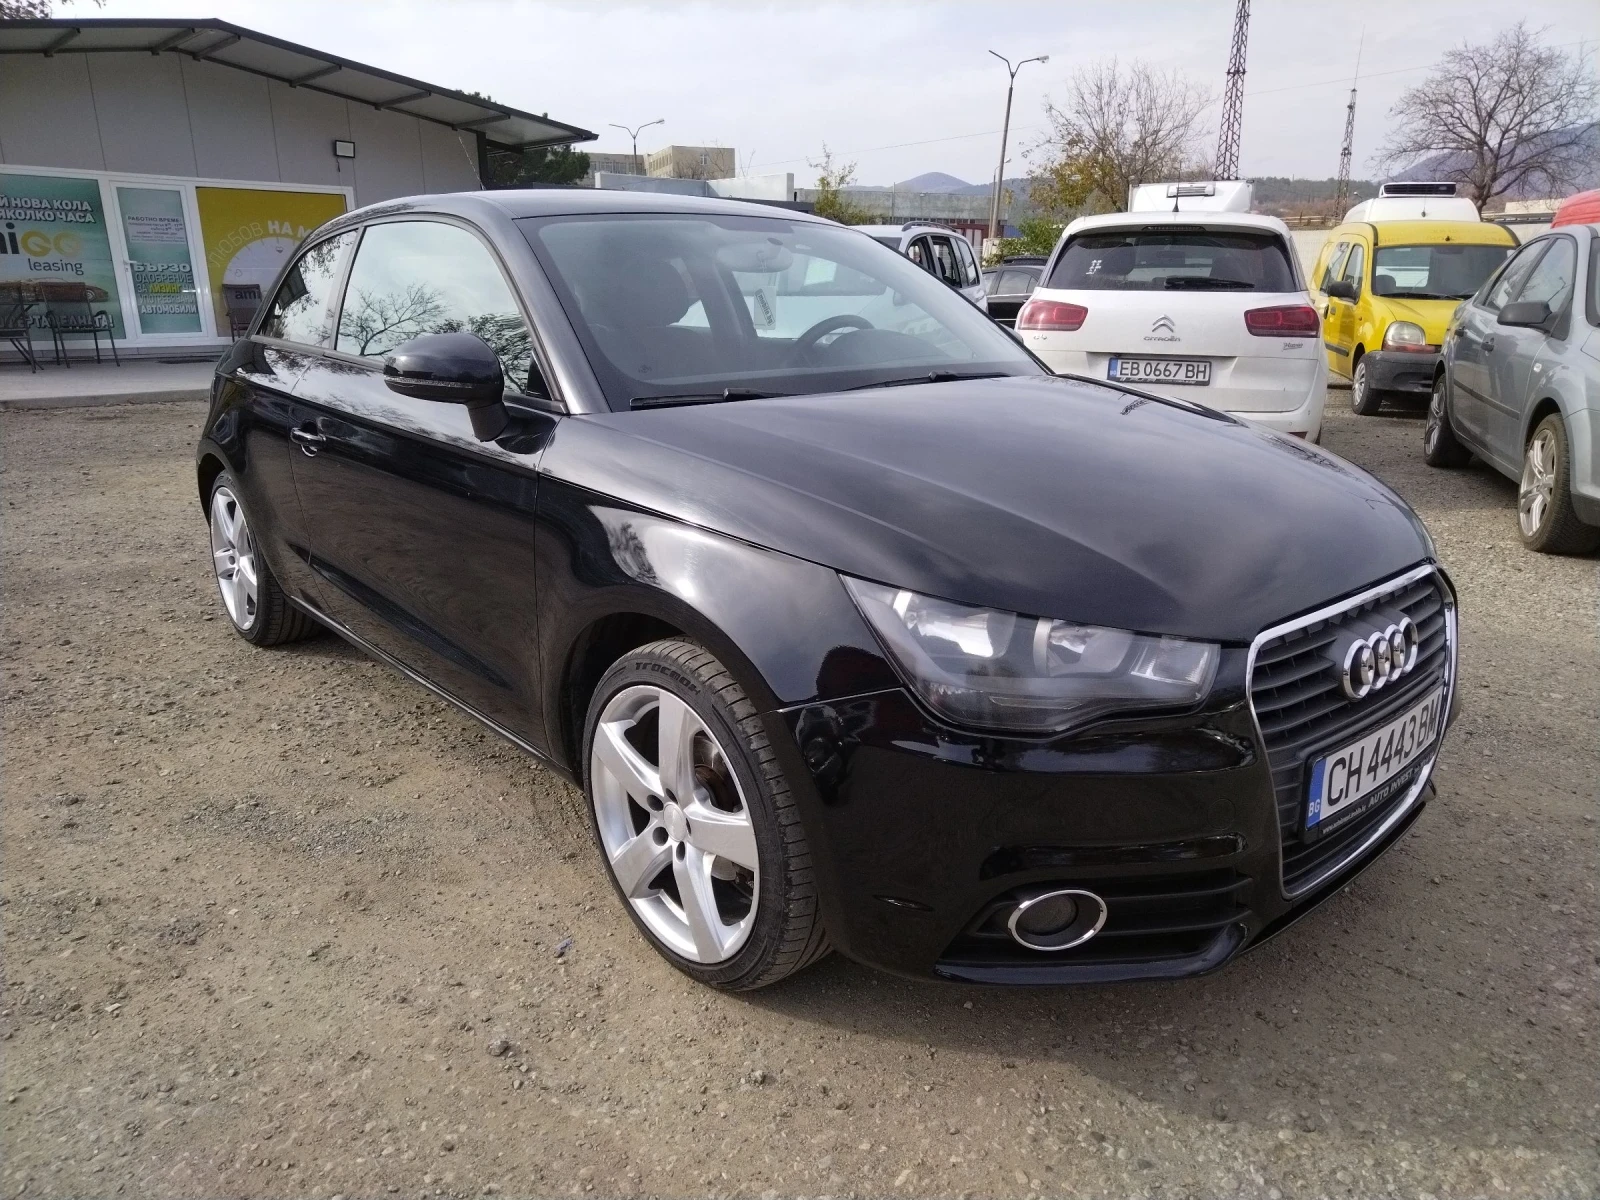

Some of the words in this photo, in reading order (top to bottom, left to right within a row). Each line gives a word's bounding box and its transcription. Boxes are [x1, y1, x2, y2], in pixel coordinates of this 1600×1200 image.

[11, 197, 52, 210] НОВА
[53, 199, 93, 212] КОЛА
[56, 211, 96, 223] ЧАСА
[209, 221, 264, 267] ЛЮБОВ
[267, 219, 294, 236] НА
[28, 258, 84, 276] leasing
[134, 262, 191, 273] БЪРЗО
[135, 273, 193, 284] ОДОБРЕНИЕ
[137, 283, 148, 293] ЗА
[150, 283, 181, 294] ЛИЗИНГ
[141, 304, 198, 315] АВТОМОБИЛИ
[1119, 361, 1141, 377] EB
[1143, 362, 1183, 378] 0667
[1184, 363, 1208, 380] BH
[1327, 745, 1366, 807] CH
[1366, 714, 1417, 782] 4443
[1416, 693, 1441, 749] BM
[1367, 783, 1390, 808] AUTO
[1389, 767, 1414, 793] INVEST
[1308, 799, 1321, 816] BG
